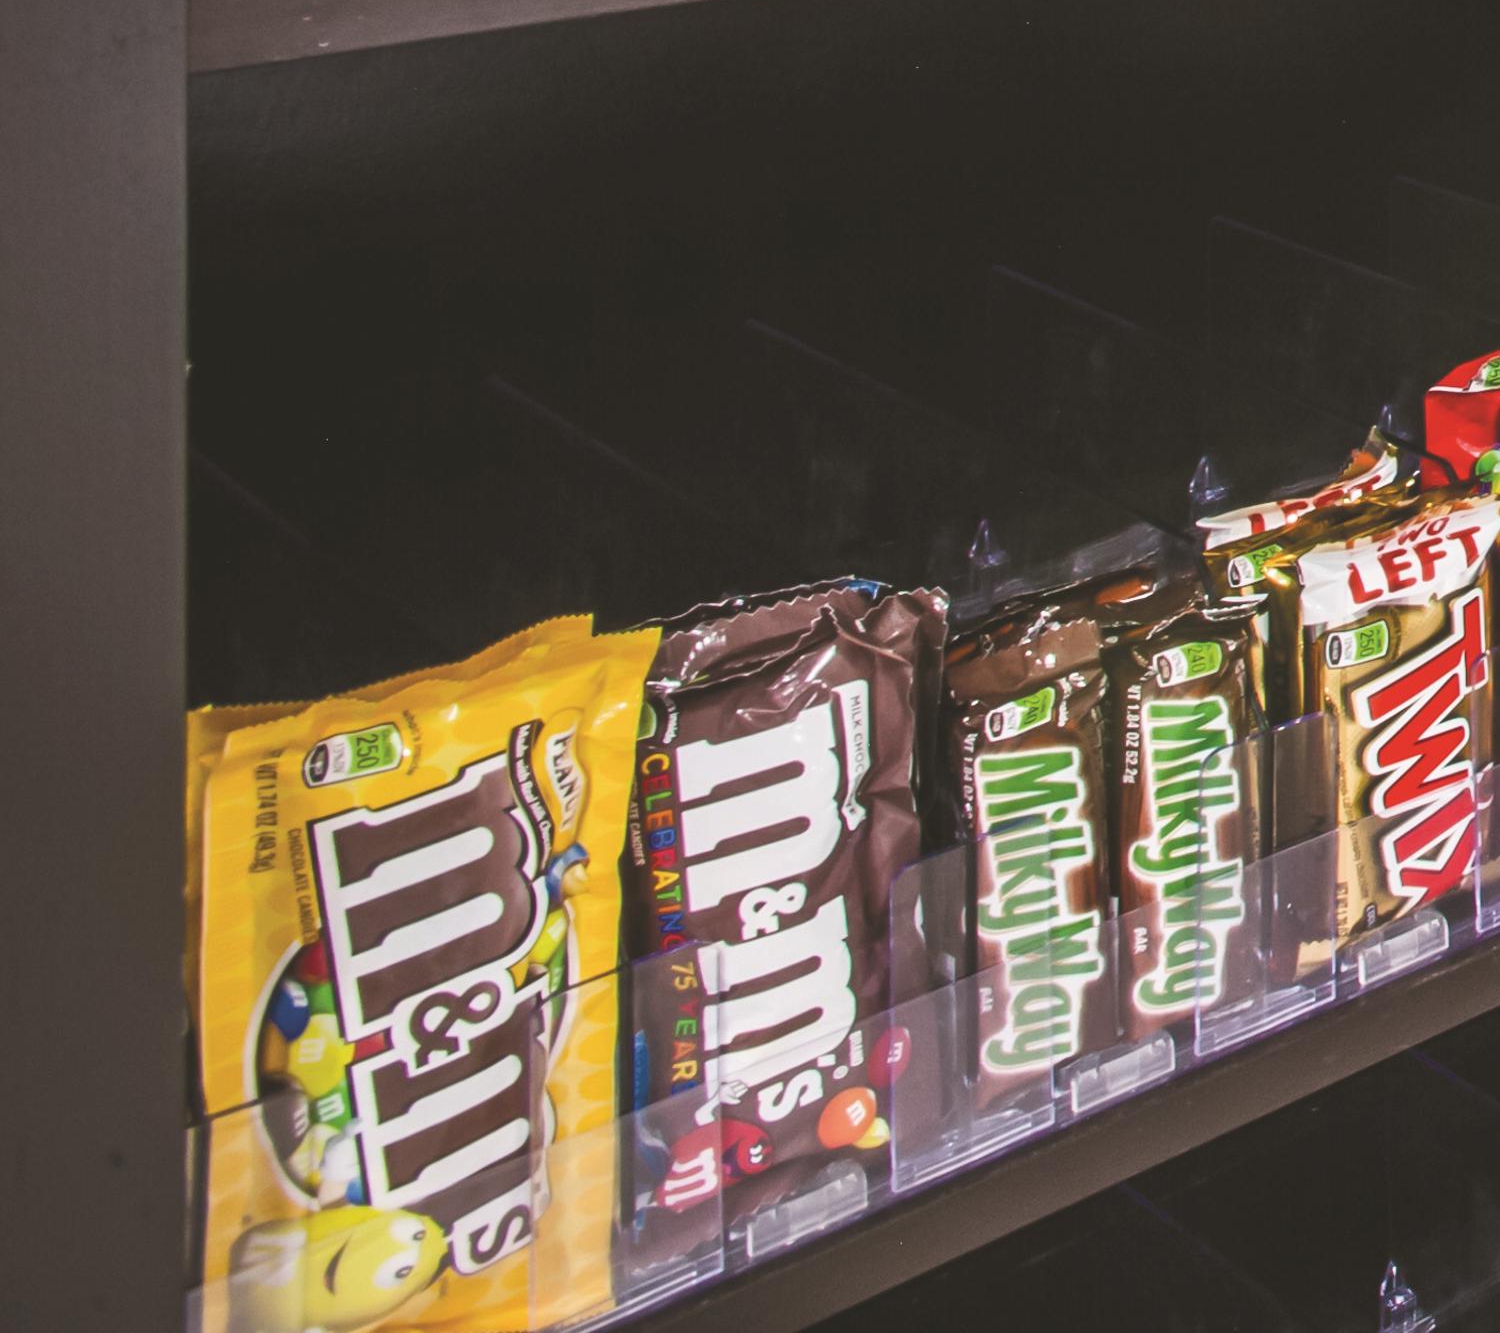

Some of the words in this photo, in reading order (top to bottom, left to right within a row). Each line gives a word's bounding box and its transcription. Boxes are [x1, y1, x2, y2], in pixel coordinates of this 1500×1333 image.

[1346, 525, 1482, 605] LEFT
[849, 694, 862, 727] MILK
[1125, 704, 1141, 732] 1.84
[1360, 591, 1492, 914] TWIX
[976, 748, 1094, 929] Milky
[1129, 697, 1242, 880] Milky
[669, 961, 700, 992] 75
[984, 911, 1104, 1072] Way
[1134, 862, 1245, 1012] Way
